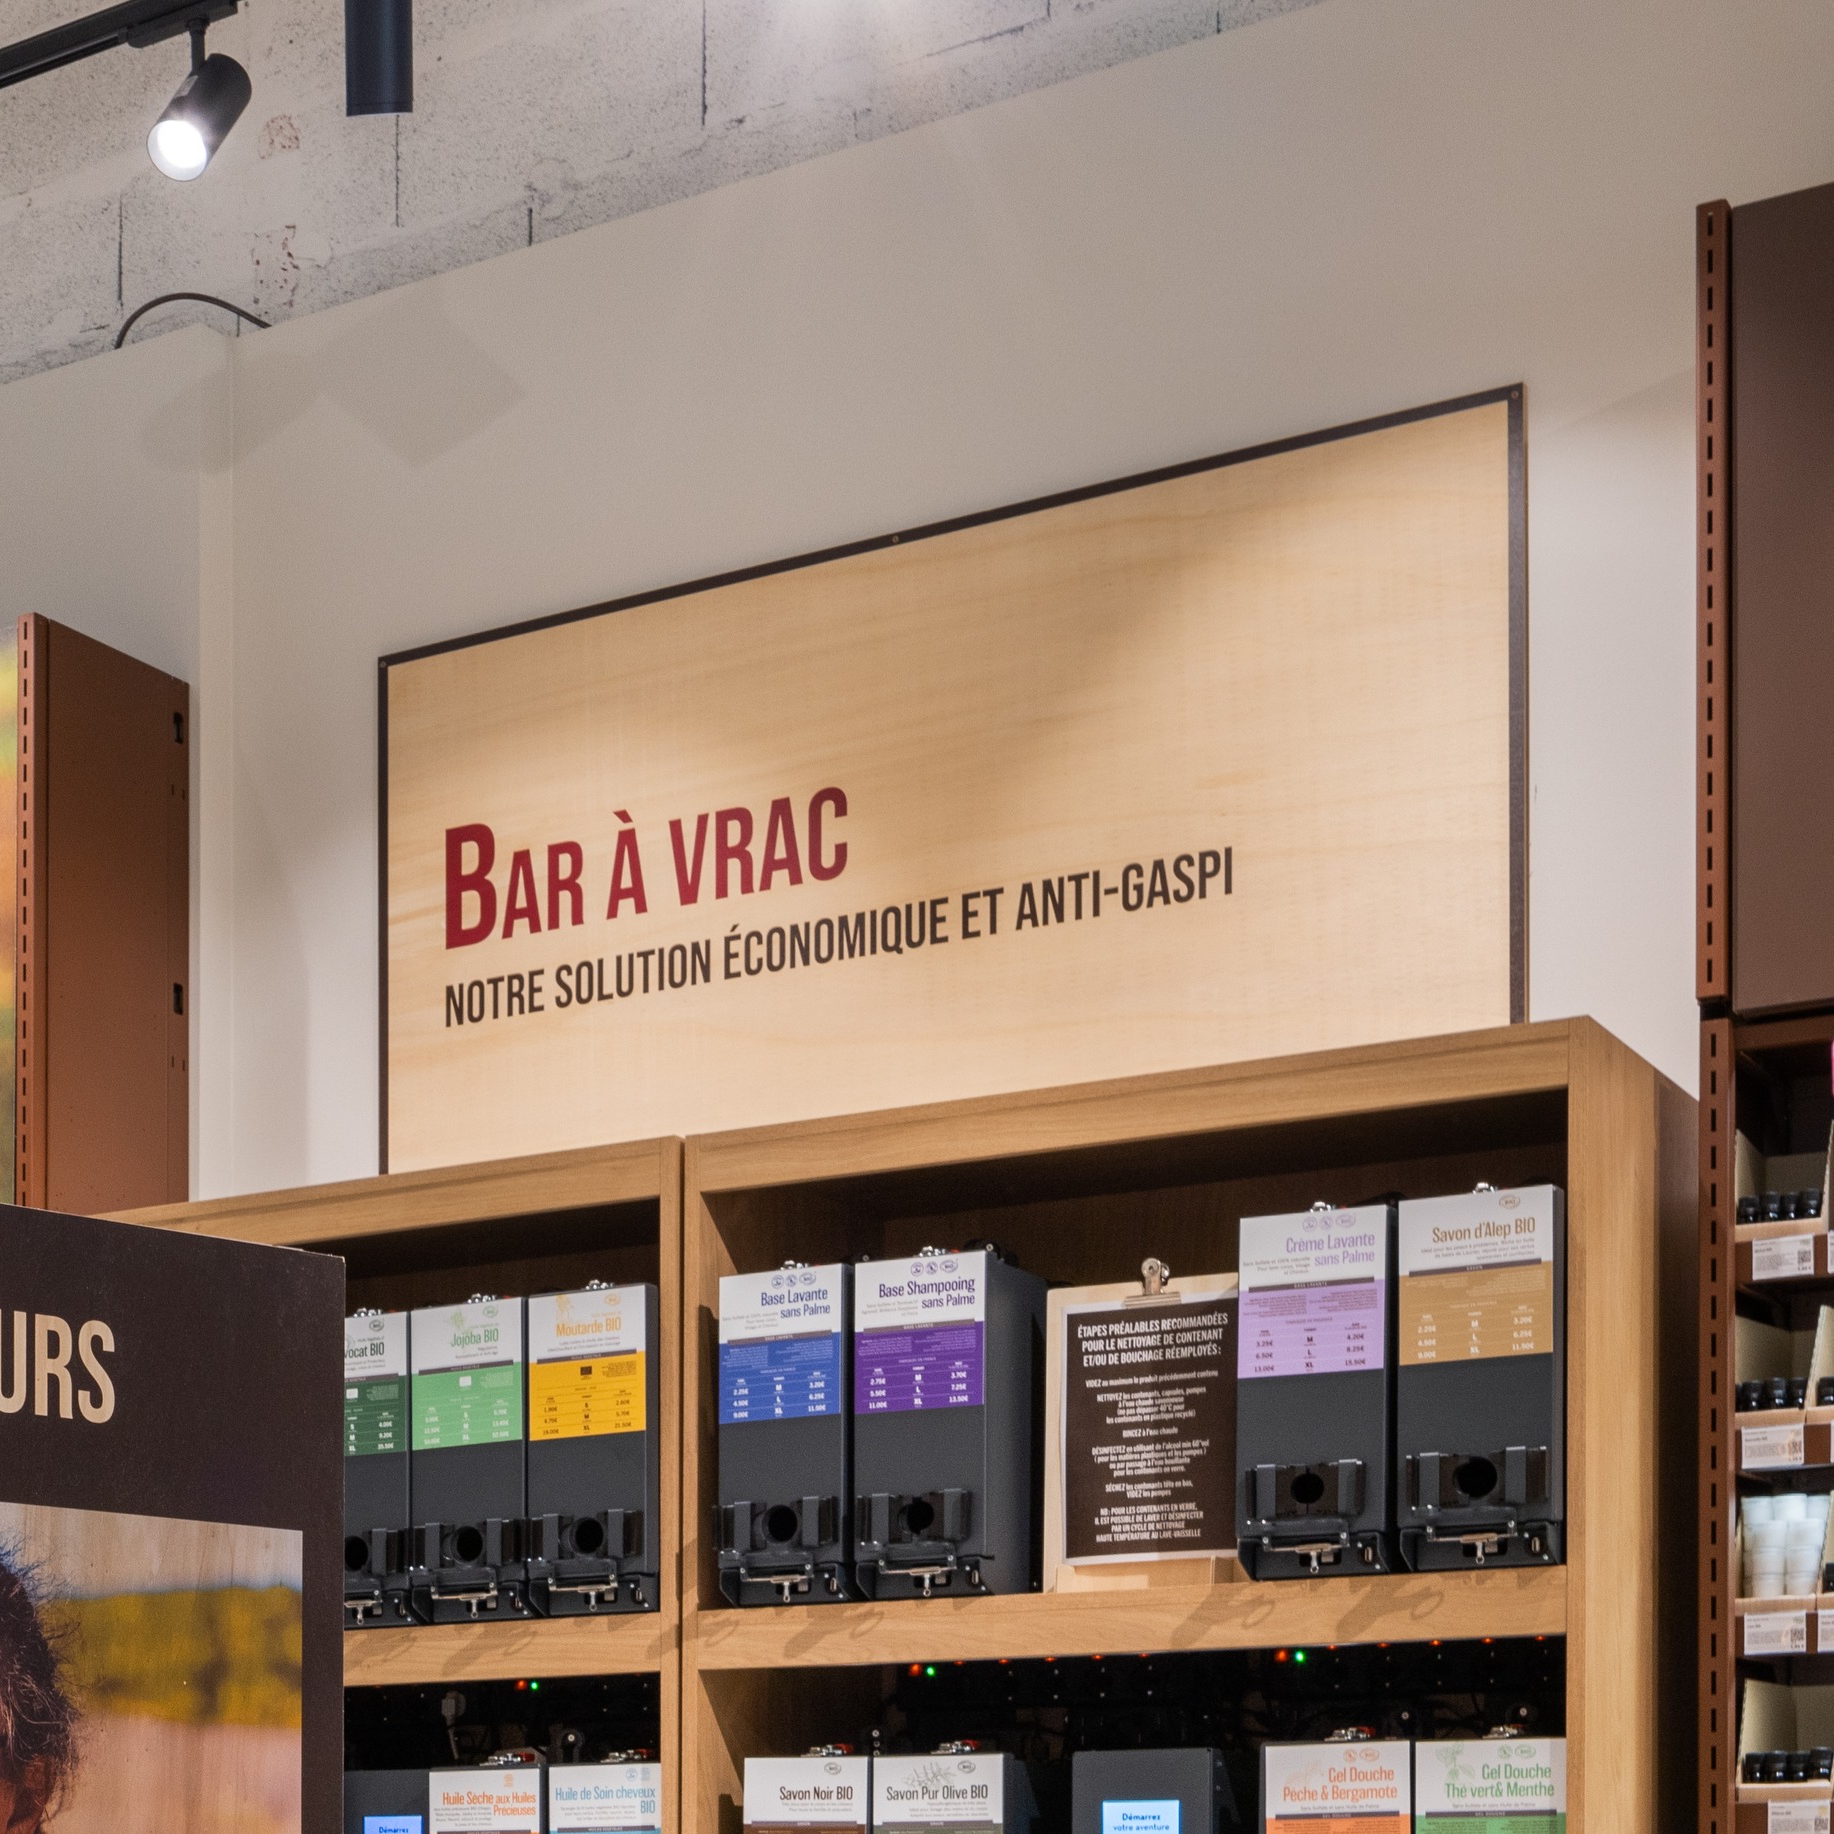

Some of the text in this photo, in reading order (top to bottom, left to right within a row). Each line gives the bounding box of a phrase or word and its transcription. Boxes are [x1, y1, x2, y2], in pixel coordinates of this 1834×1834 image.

[445, 786, 848, 949] BAR À VRAC
[445, 846, 1233, 1028] NOTRE SOLUTION ÉCONOMIQUE ET ANTI-GASPI
[1432, 1217, 1536, 1244] Savon d'Alep BIO
[1286, 1233, 1375, 1254] Crème Lavante
[1314, 1254, 1339, 1267] sans
[1342, 1250, 1375, 1264] Palme
[879, 1276, 976, 1299] Base Shampooing
[761, 1288, 828, 1307] Base Lavante
[921, 1297, 944, 1309] sans
[946, 1293, 976, 1306] Palme
[780, 1303, 831, 1319] sans Palme
[555, 1317, 622, 1338] Moutarde BIO
[1077, 1311, 1228, 1338] ÉTAPES PRÉALABLES RECOMMANDÉES
[450, 1328, 499, 1349] Jojoba BIO
[1082, 1328, 1223, 1353] POUR LE NETTOYAGE DE CONTENANT
[370, 1341, 385, 1356] BIO
[1083, 1353, 1107, 1367] ET/OU
[1108, 1352, 1119, 1365] DE
[1120, 1348, 1164, 1364] BOUCHAGE
[1328, 1766, 1395, 1783] Gel Douche
[1481, 1763, 1552, 1780] Gel Douche
[442, 1791, 536, 1806] Huile Sèche aux Huiles
[555, 1785, 656, 1801] Huile de Soin cheveux
[779, 1786, 854, 1801] Savon Noir BIO
[886, 1784, 988, 1801] Savon Pur Olive BIO
[1320, 1785, 1329, 1801] &
[1331, 1784, 1398, 1803] Bergamote
[1445, 1782, 1467, 1799] Thé
[1506, 1781, 1555, 1797] Menthe
[493, 1804, 536, 1817] Précieuses
[640, 1800, 656, 1814] BIO
[1113, 1823, 1170, 1832] votre aventure
